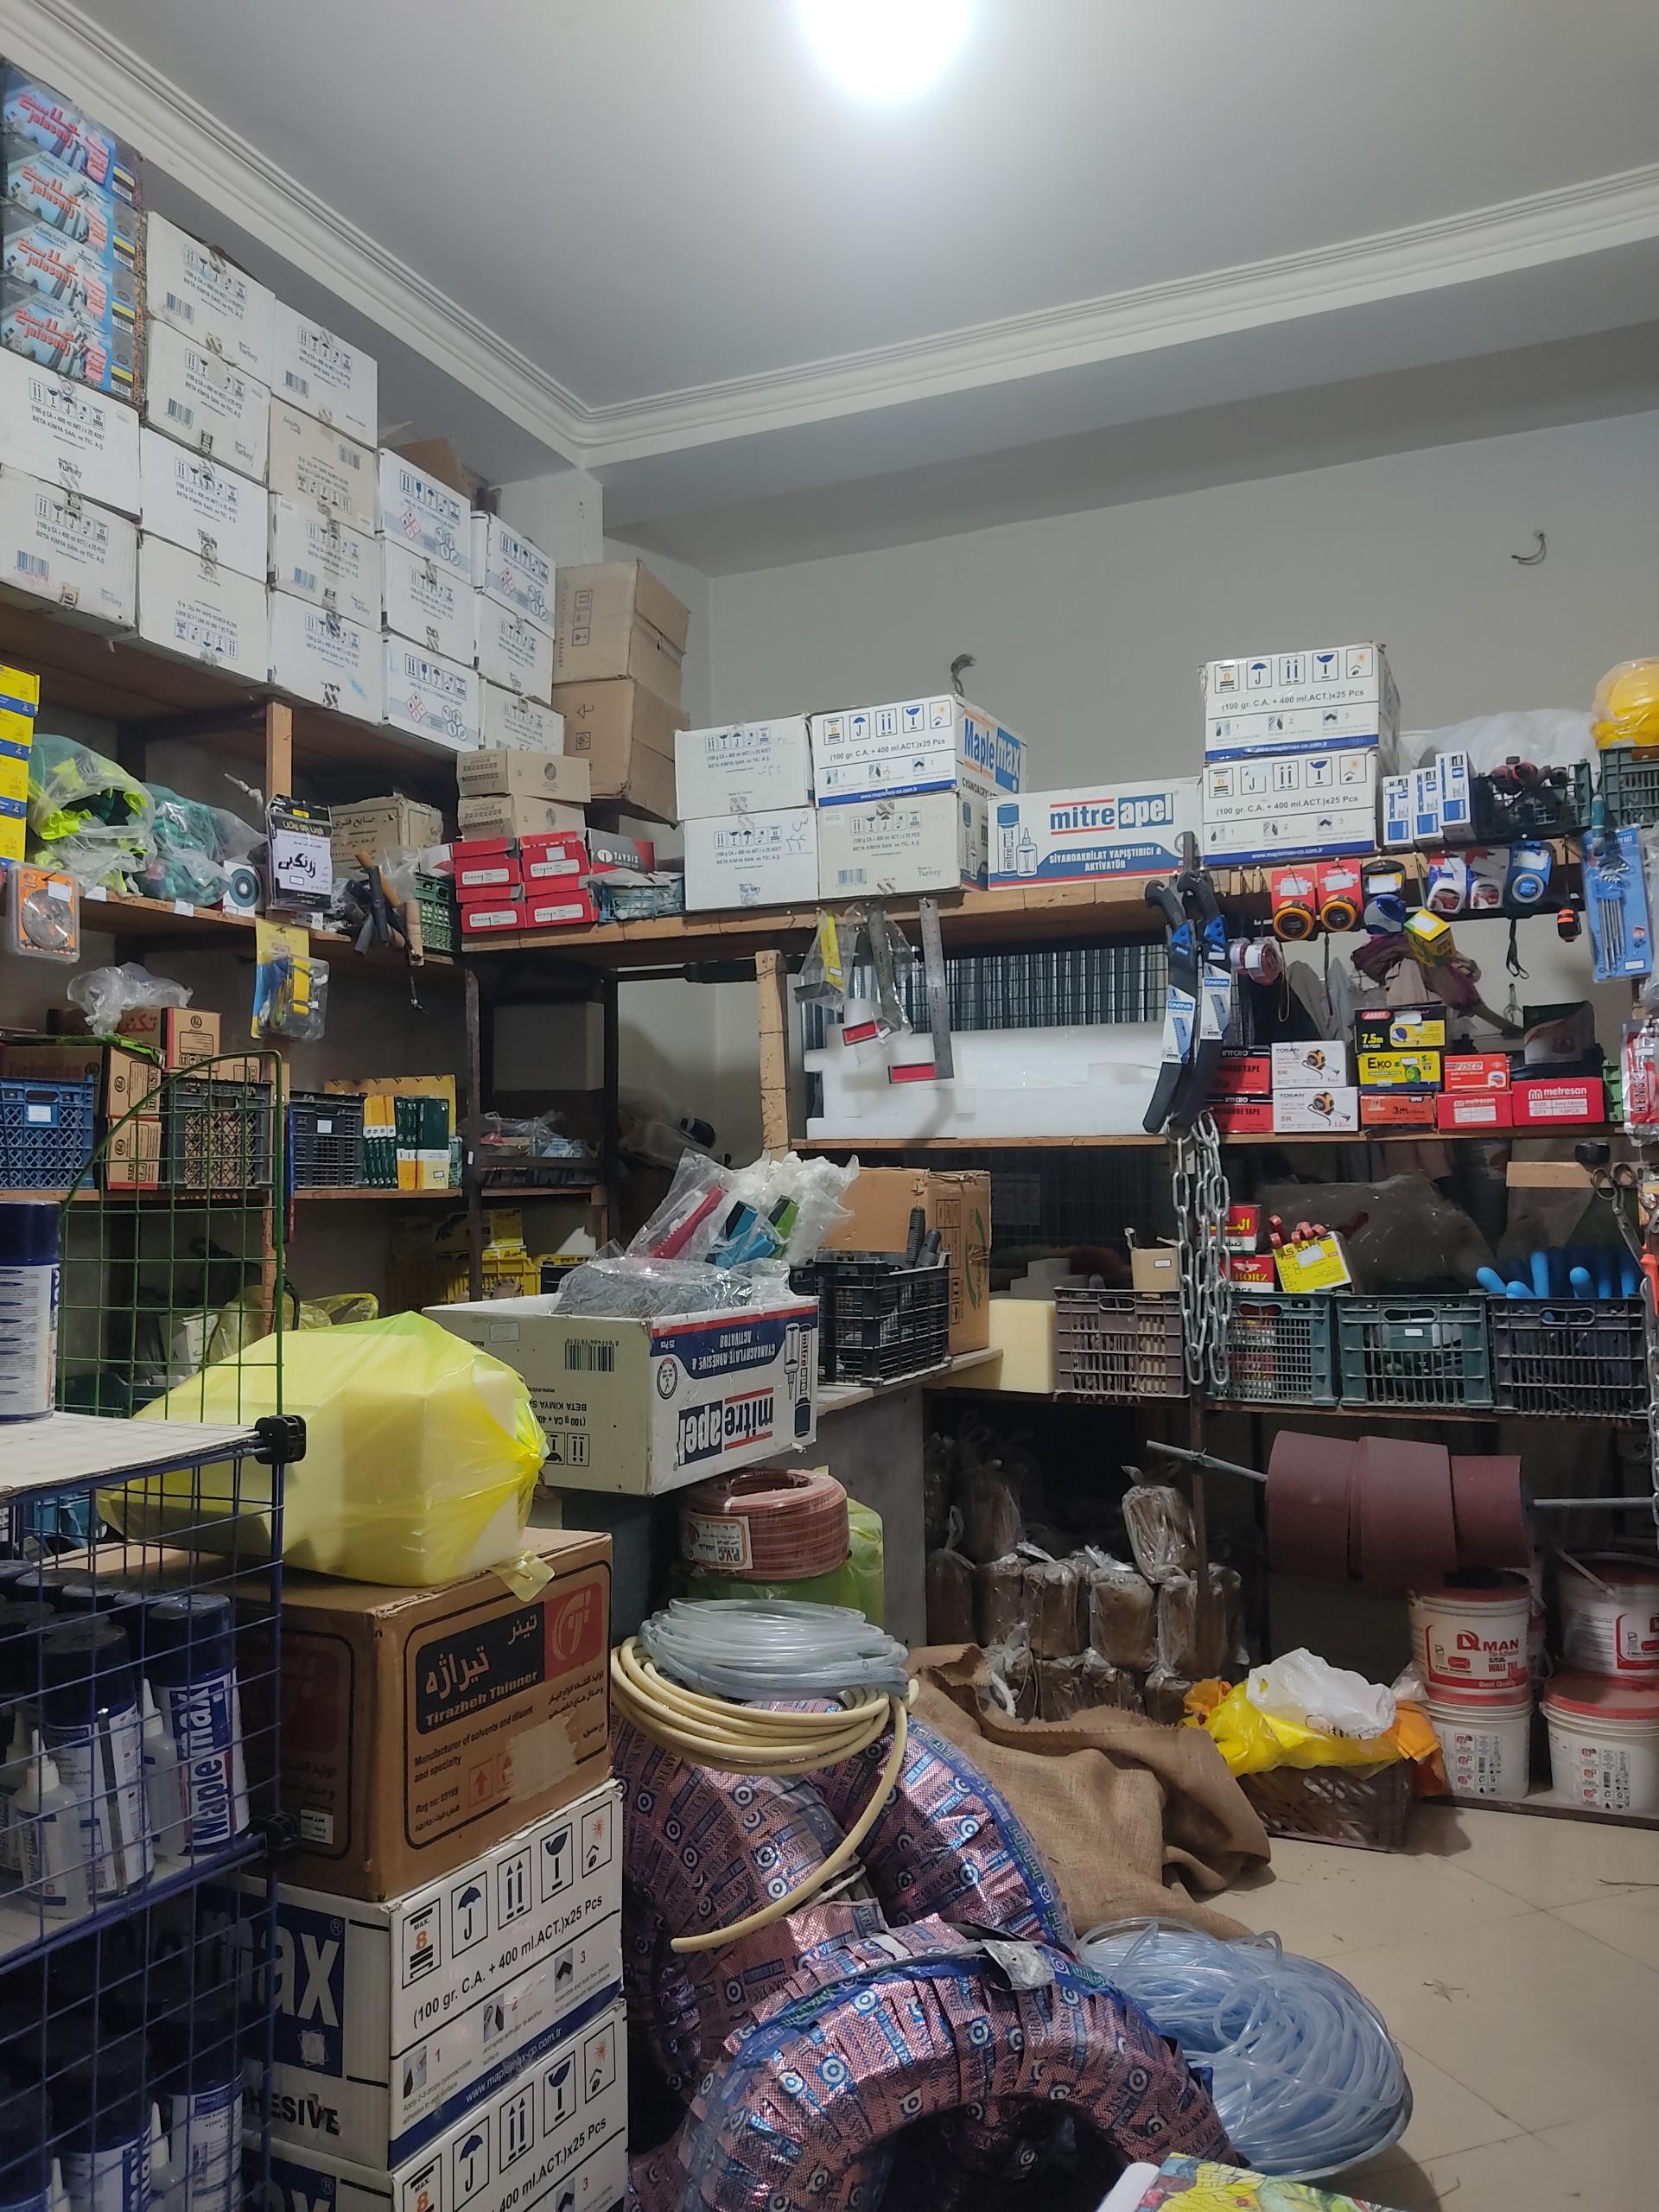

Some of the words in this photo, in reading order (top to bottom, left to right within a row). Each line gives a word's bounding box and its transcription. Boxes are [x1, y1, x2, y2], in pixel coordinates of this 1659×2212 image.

[1222, 702, 1238, 712] (100
[1242, 702, 1250, 710] gr.
[1362, 1033, 1383, 1044] 7.5m
[1368, 1058, 1392, 1069] EKO
[1235, 1273, 1268, 1282] BORZ
[720, 1331, 753, 1348] ACTIVATOR
[566, 1402, 587, 1411] BETA
[554, 1416, 563, 1425] CA
[565, 1417, 569, 1426] g
[570, 1416, 586, 1427] (100
[508, 1612, 537, 1645] تینر
[425, 1644, 491, 1700] تیراژه
[1488, 1662, 1506, 1672] WALL
[425, 1688, 487, 1728] Tirazheh
[489, 1670, 538, 1700] Thinner
[414, 1738, 461, 1767] Manufacturer
[462, 1732, 470, 1745] of
[470, 1721, 499, 1743] solvents
[499, 1715, 512, 1729] and
[414, 1770, 429, 1783] and
[429, 1756, 461, 1782] specialty
[414, 1917, 430, 1932] MAX.
[416, 1930, 427, 1950] 8
[413, 1998, 439, 2030] (100
[443, 1989, 458, 2009] gr.
[462, 1970, 486, 1993] C.A.
[488, 1964, 495, 1974] +
[499, 1946, 518, 1967] 400
[585, 1896, 603, 1915] Pcs
[580, 1950, 586, 1964] 3
[435, 2048, 441, 2063] 1
[588, 2118, 607, 2140] Pcs
[415, 2178, 430, 2195] MAX.
[583, 2177, 588, 2191] 3
[417, 2190, 429, 2212] 8
